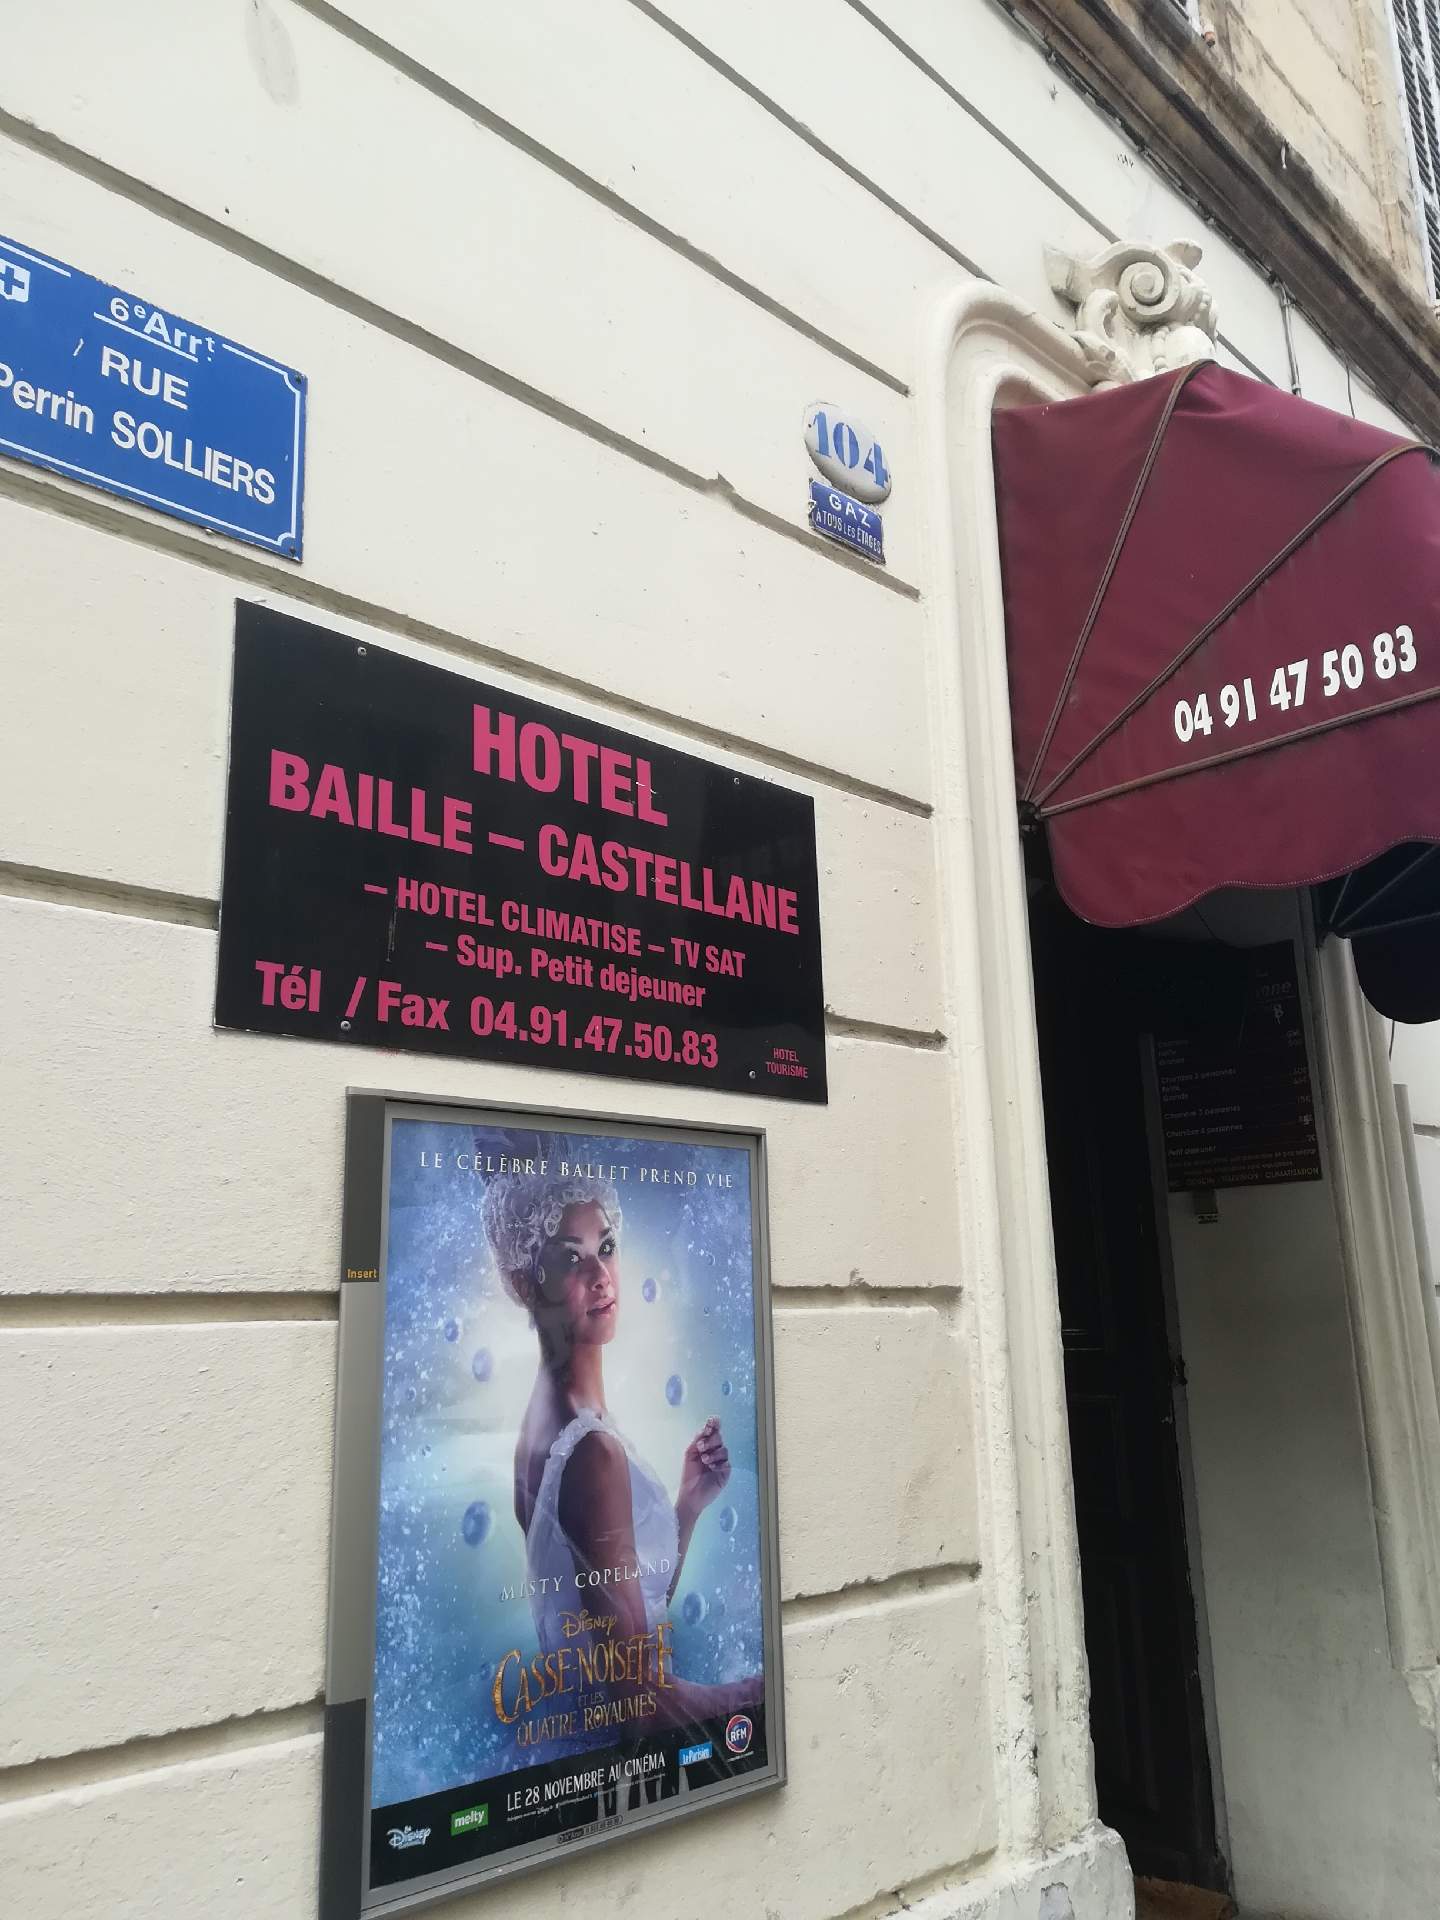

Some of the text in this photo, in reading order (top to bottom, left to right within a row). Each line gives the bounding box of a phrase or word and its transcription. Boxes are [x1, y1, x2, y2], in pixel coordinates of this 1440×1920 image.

[101, 346, 189, 410] RUE
[111, 410, 276, 505] SOLLIERS
[813, 411, 889, 488] 104
[822, 510, 843, 531] TOUS
[844, 522, 856, 538] LES
[829, 493, 871, 528] GAZ
[1174, 624, 1417, 743] 04 91 47 50 83
[472, 703, 668, 827] HOTEL
[268, 748, 473, 854] BAILLE
[538, 823, 799, 935] CASTELLANE
[397, 877, 494, 926] HOTEL
[501, 900, 642, 957] CLIMATISE
[670, 936, 700, 968] TV
[705, 945, 746, 978] SAT
[456, 934, 522, 978] Sup.
[531, 948, 593, 987] Petit
[600, 963, 705, 1008] dejeuner
[255, 960, 321, 1012] Tél
[377, 980, 450, 1031] Fax
[470, 995, 719, 1069] 04.91.47.50.83
[765, 1060, 809, 1079] TOURISME
[773, 1047, 799, 1063] HOTEL
[420, 1151, 733, 1188] LE CÉLÈBRE BALLET PREND VIE
[347, 1268, 377, 1279] Insert
[501, 1558, 671, 1602] MISTY COPELAND
[493, 1621, 674, 1724] CASSE-NOISETTE
[516, 1691, 657, 1747] QUATRE ROYAUMES
[730, 1726, 747, 1742] RFM
[507, 1791, 522, 1812] LE
[525, 1785, 540, 1807] 28
[544, 1768, 605, 1801] NOVEMBRE
[608, 1761, 622, 1783] AU
[624, 1751, 666, 1777] CINÉMA
[454, 1810, 485, 1828] melty
